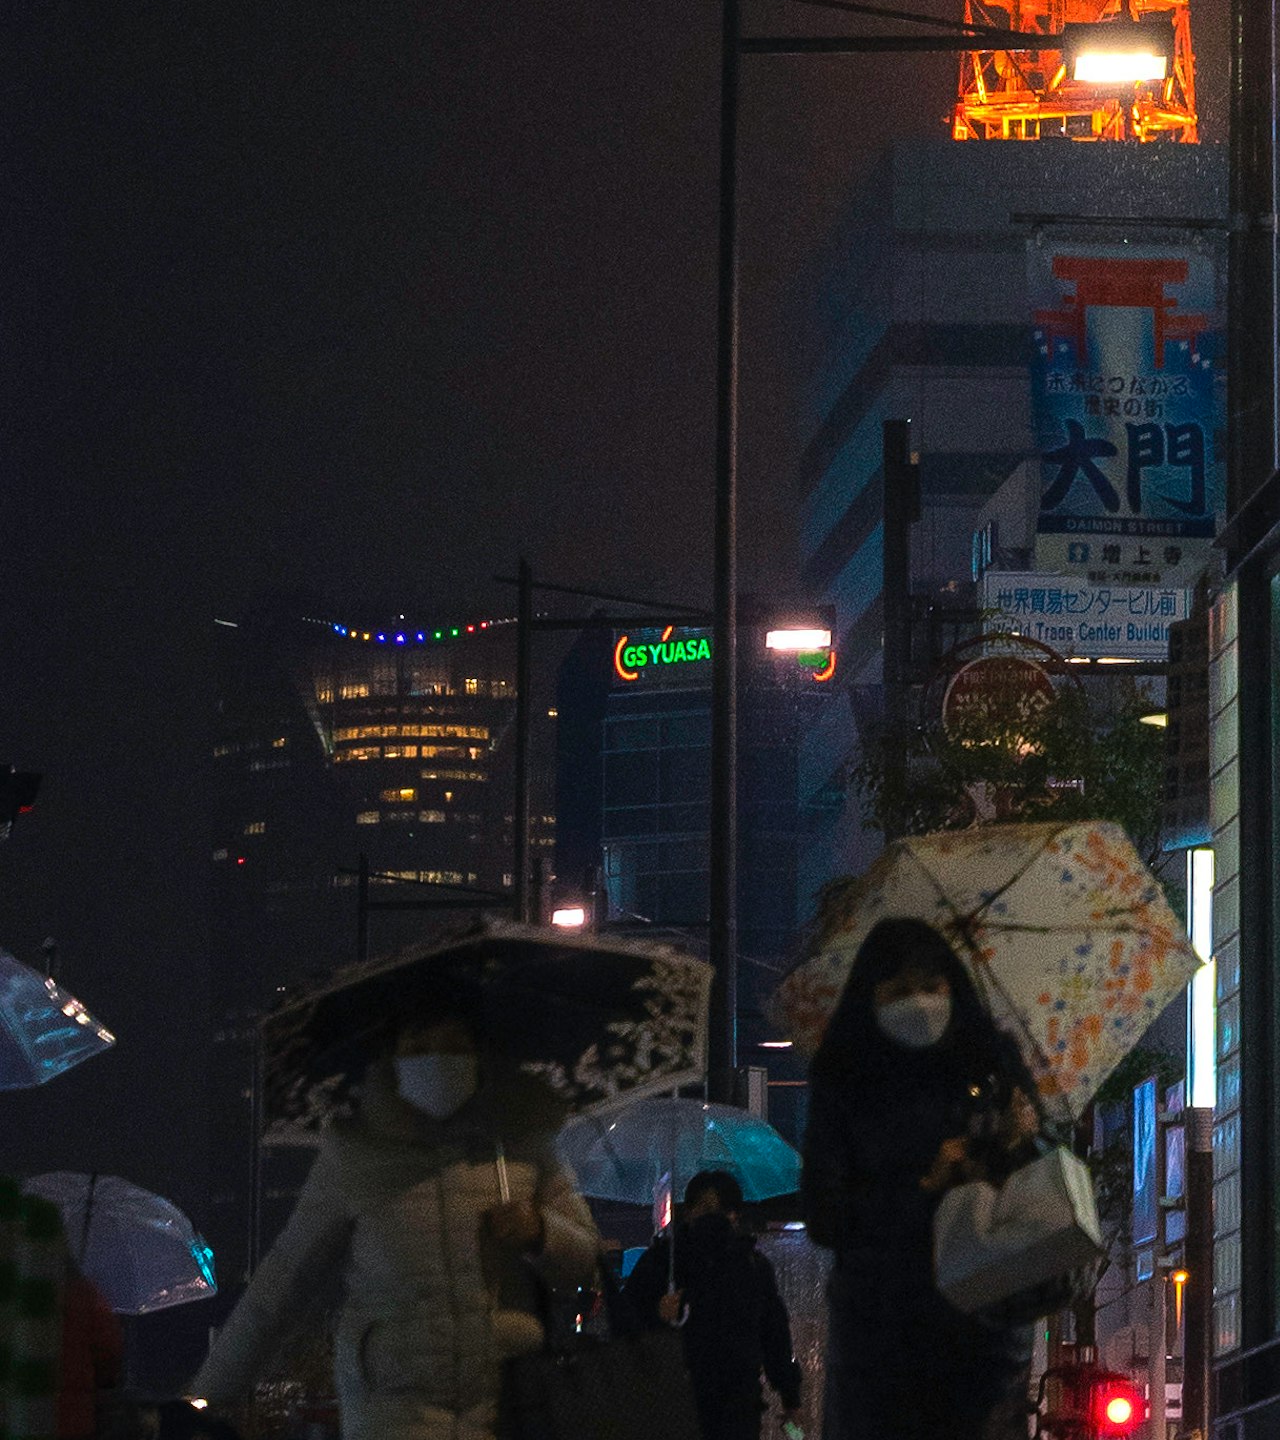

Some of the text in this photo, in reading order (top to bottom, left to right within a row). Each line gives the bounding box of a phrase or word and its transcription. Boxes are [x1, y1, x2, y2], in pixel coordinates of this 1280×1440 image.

[1084, 395, 1166, 418] 歴史の街
[1041, 418, 1207, 516] 大門
[1066, 521, 1184, 535] DAIMON STREET
[1102, 543, 1182, 566] 増上寺
[999, 588, 1177, 617] 世界貿易センタービル前
[1036, 623, 1073, 641] Trade
[1079, 622, 1122, 641] Center
